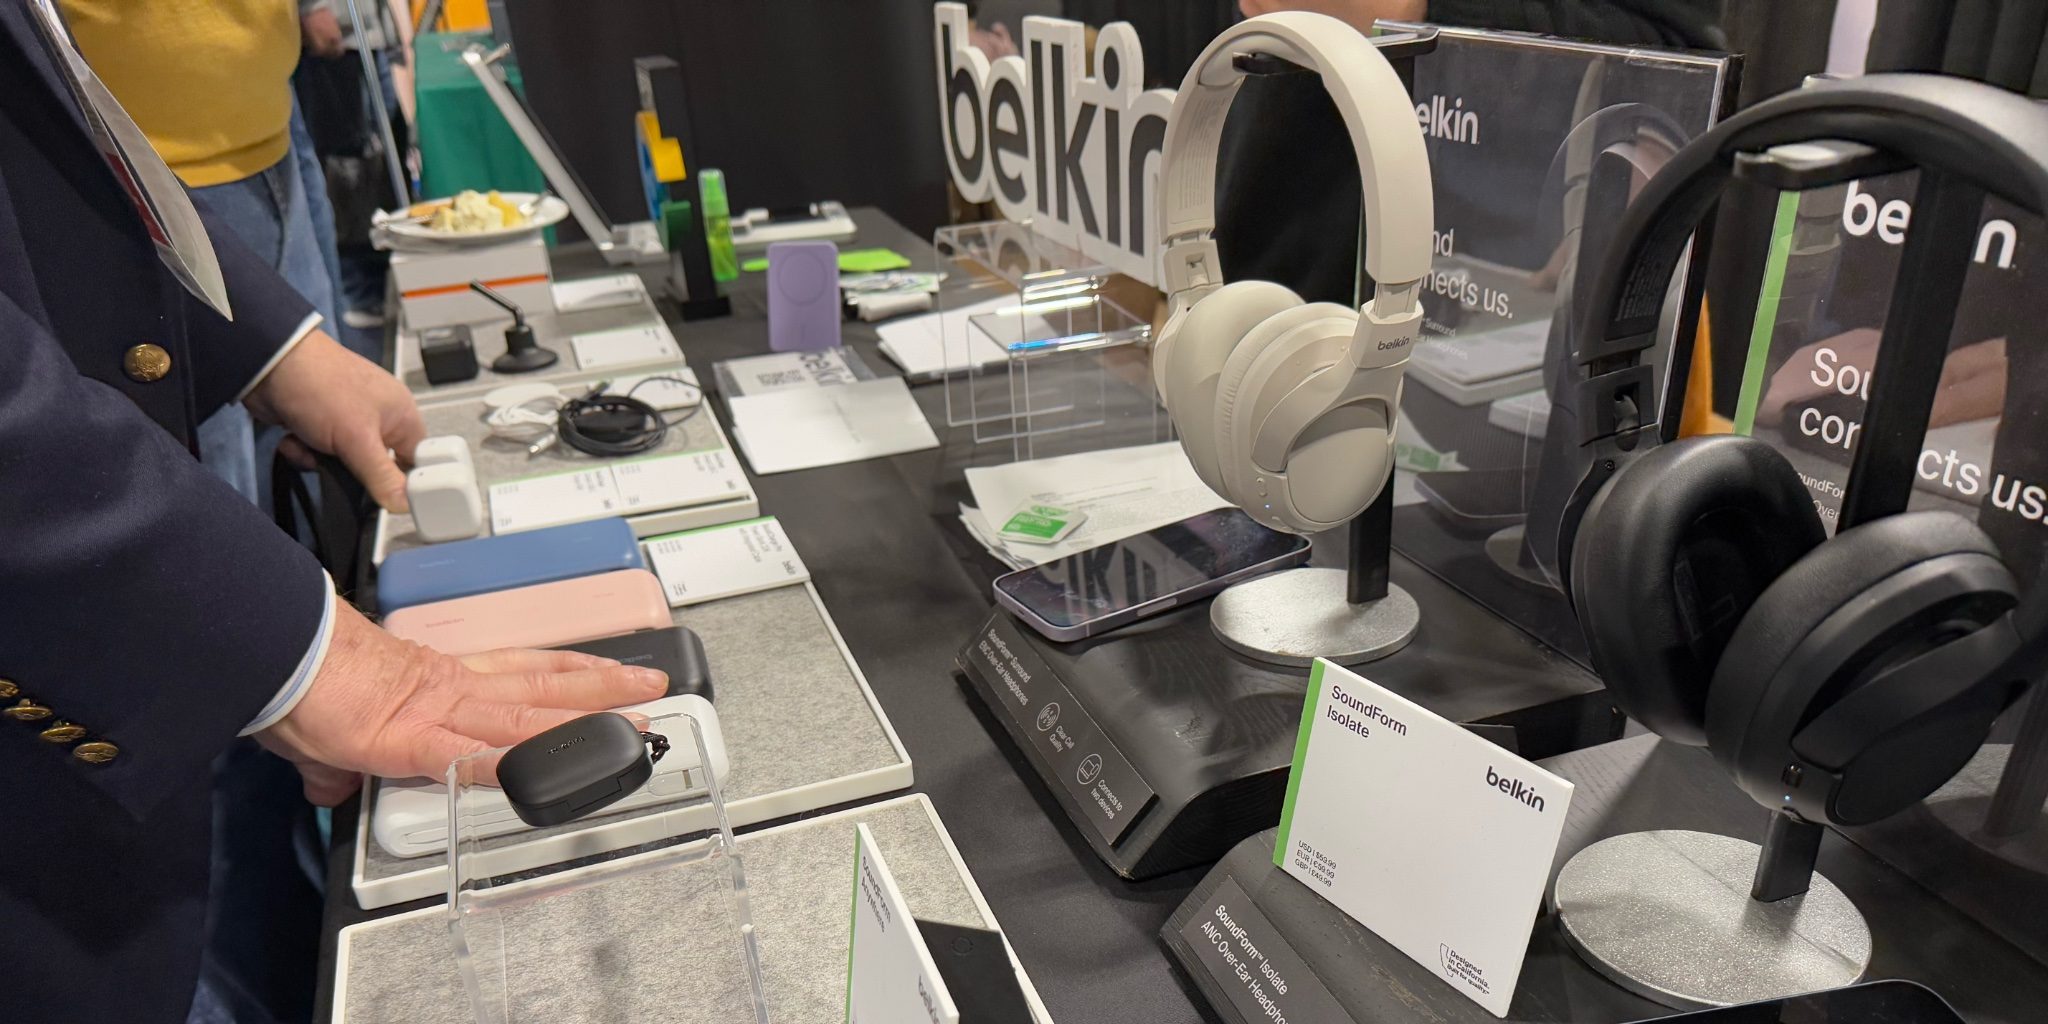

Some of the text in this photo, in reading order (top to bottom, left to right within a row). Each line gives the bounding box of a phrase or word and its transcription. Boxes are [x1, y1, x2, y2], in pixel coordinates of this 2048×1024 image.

[1415, 94, 1479, 145] elkin
[1843, 178, 2017, 269] ben
[1483, 287, 1513, 319] us.
[1377, 335, 1410, 351] belkin
[1992, 473, 2048, 526] us.
[1010, 656, 1032, 683] Surround
[1001, 670, 1029, 706] Headphones
[1326, 704, 1370, 739] Isolate
[1331, 685, 1408, 737] SoundForm
[1049, 733, 1064, 753] Quality
[1090, 787, 1115, 820] two devices
[1098, 779, 1123, 812] Connects to
[1486, 765, 1545, 813] belkin
[1297, 850, 1309, 862] EUR
[1298, 840, 1312, 854] USD
[1295, 858, 1308, 870] GBP
[1200, 921, 1289, 1024] ANC Over-Ear Headpho
[1259, 959, 1288, 995] Isolate
[1447, 964, 1459, 975] Built
[1459, 972, 1468, 981] for
[1450, 950, 1482, 975] Designed
